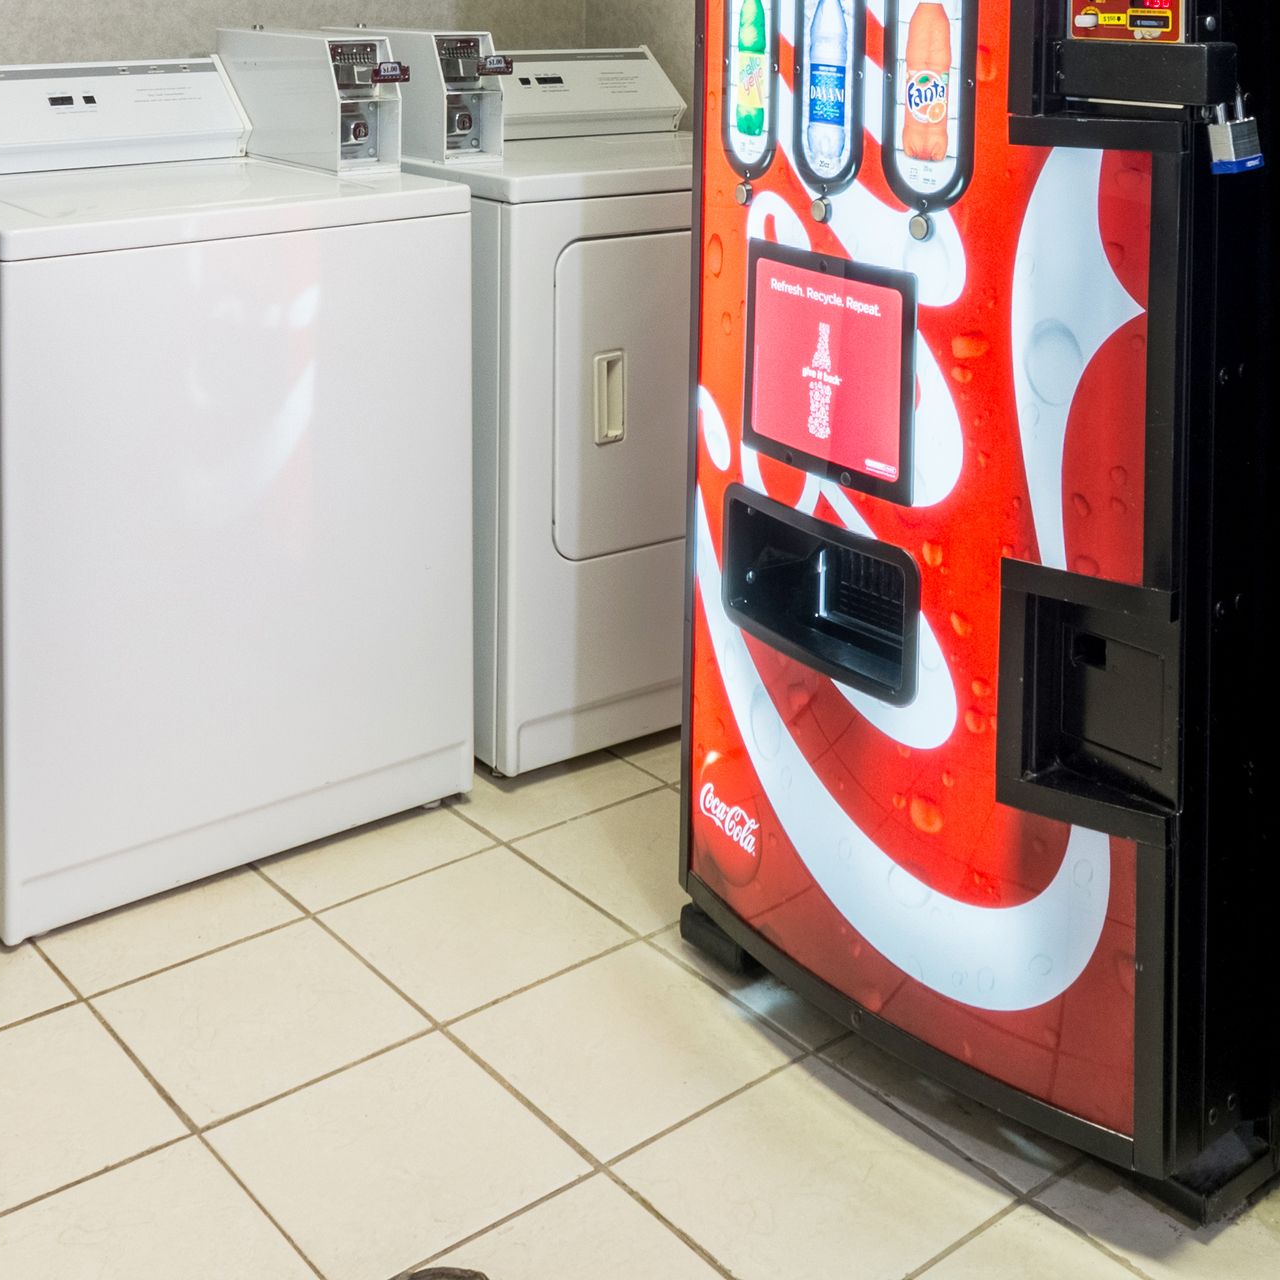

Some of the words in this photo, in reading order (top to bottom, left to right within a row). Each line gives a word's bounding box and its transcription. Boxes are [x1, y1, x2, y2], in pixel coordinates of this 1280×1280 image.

[382, 65, 398, 74] $1.00
[810, 84, 845, 103] DASANI
[907, 80, 946, 111] Fanta
[770, 278, 805, 298] Refresh.
[806, 287, 845, 308] Recycle.
[846, 296, 882, 317] Repeat.
[700, 783, 760, 854] Coca-Cola
